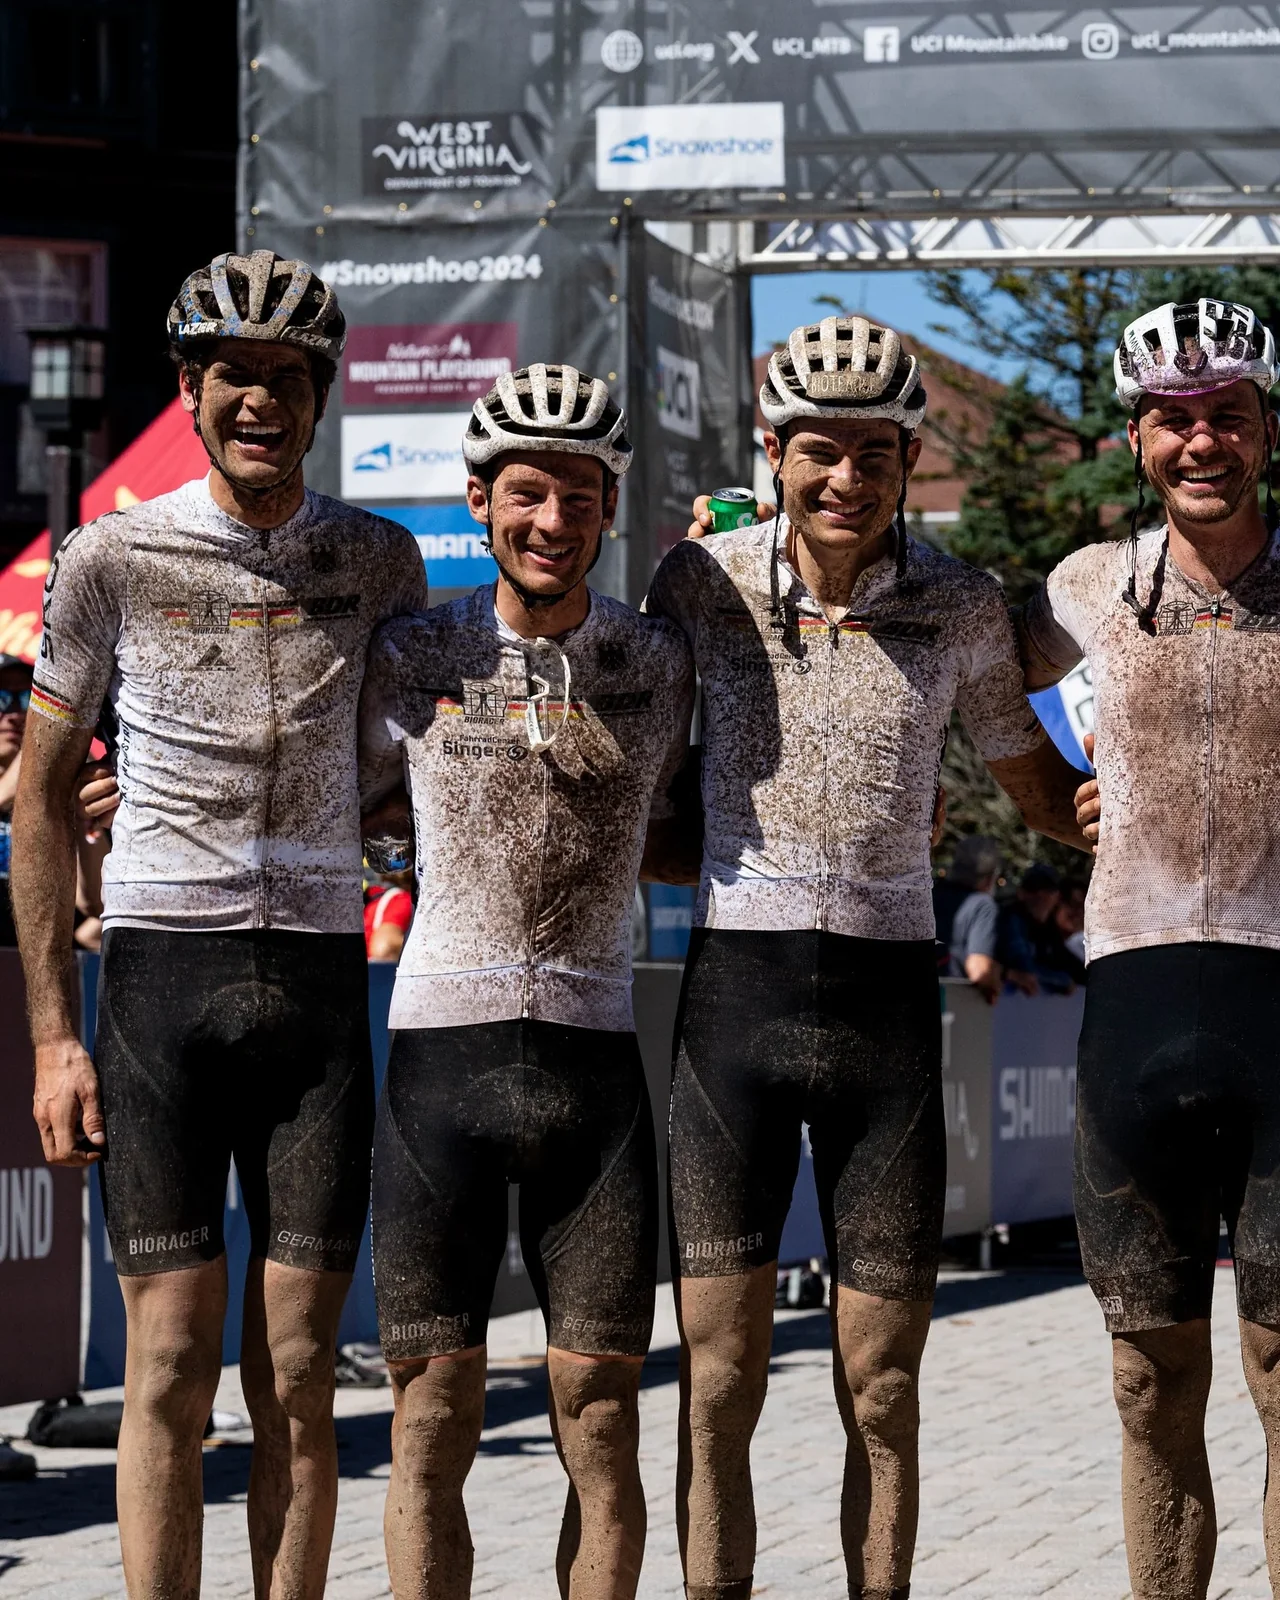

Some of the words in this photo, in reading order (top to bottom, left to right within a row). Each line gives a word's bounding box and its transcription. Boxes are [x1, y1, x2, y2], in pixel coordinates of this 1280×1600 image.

[911, 35, 943, 53] UCI
[945, 32, 1070, 52] Mountainbike
[397, 121, 492, 146] WEST
[655, 137, 774, 157] Snowshoe
[372, 144, 533, 176] VIRGINIA
[319, 253, 544, 286] #Snowshoe2024
[178, 322, 218, 336] LAZER
[349, 360, 420, 382] MOUNTAIN
[421, 357, 512, 381] PLAYGROUND
[464, 716, 505, 725] BIORACER
[442, 740, 505, 760] Singer
[129, 1225, 210, 1256] BIORACER
[685, 1231, 764, 1260] BIORACER
[390, 1311, 471, 1342] BIORACER
